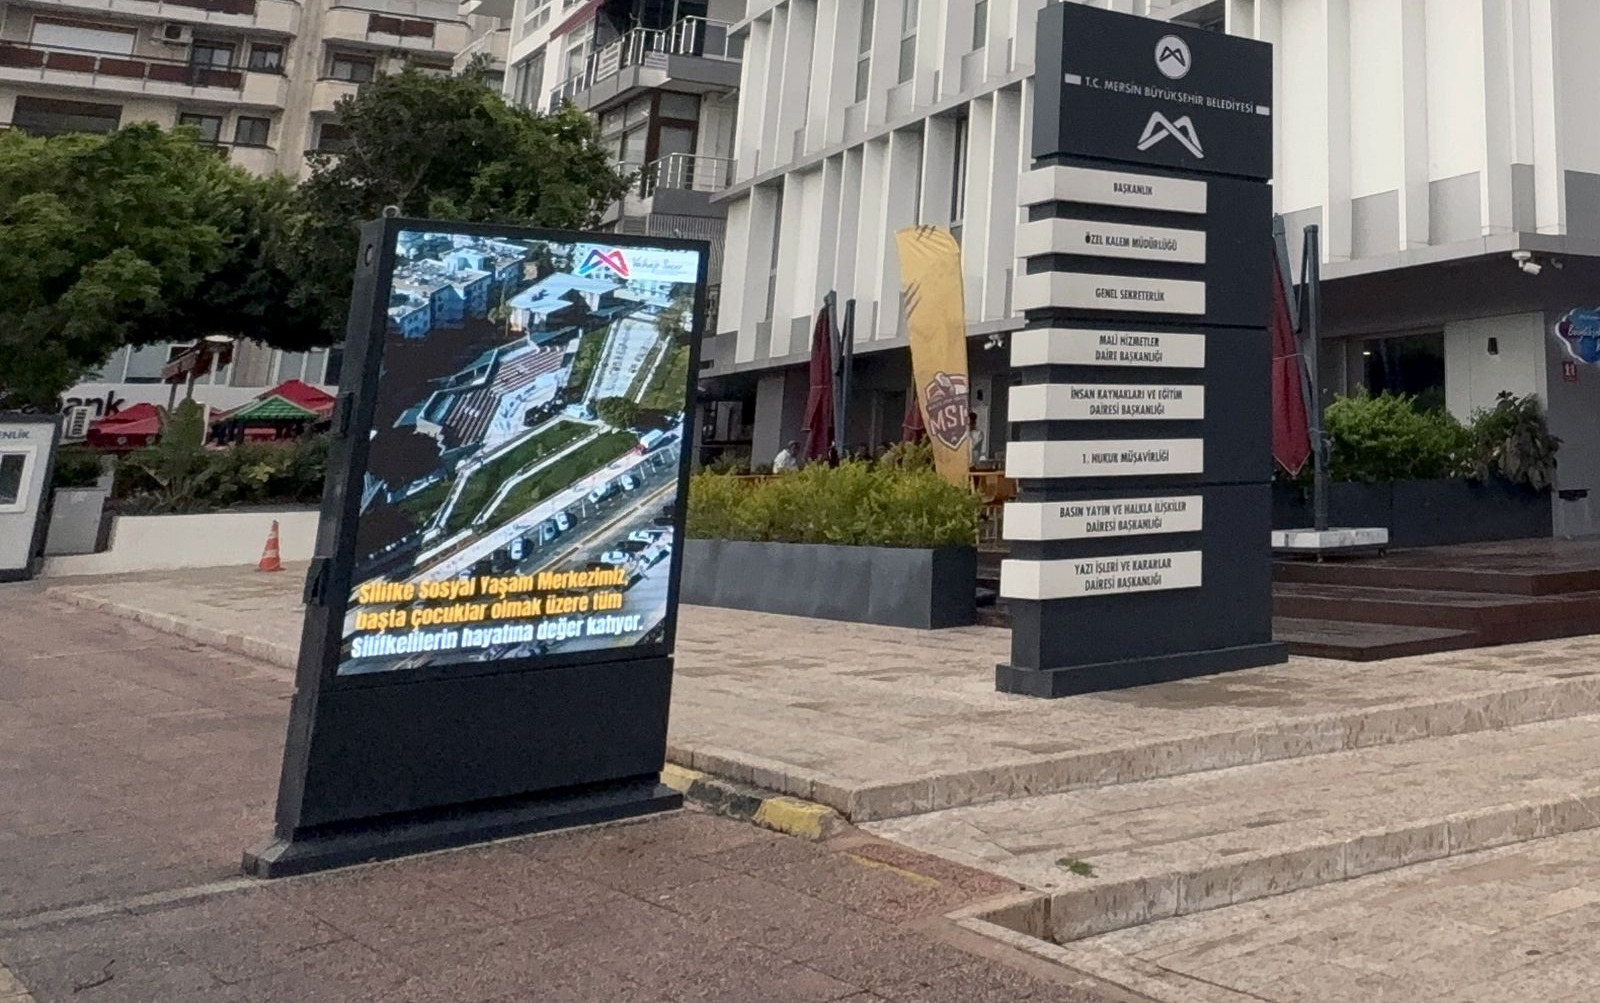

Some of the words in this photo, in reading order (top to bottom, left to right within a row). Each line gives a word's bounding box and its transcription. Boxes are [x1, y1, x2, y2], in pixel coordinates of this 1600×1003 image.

[1085, 77, 1101, 88] T.C.
[1104, 81, 1141, 95] MERSİN
[1206, 96, 1254, 113] BELEDİYESİ
[1113, 182, 1153, 195] BAŞKANLIK
[1085, 232, 1103, 245] ÖZEL
[1105, 236, 1130, 247] KALEM
[1132, 236, 1177, 251] MÜDÜRLÜĞÜ
[1095, 288, 1119, 299] GENEL
[1120, 289, 1165, 301] SEKRETERLİK
[1099, 334, 1118, 346] MALİ
[1120, 334, 1159, 347] HİZMETLER
[1095, 349, 1118, 361] DAİRE
[1120, 350, 1163, 363] BAŞKANLIĞI
[1070, 386, 1095, 399] İNSAN
[1097, 389, 1145, 399] KAYNAKLARI
[1147, 389, 1156, 399] VE
[1158, 387, 1183, 400] EĞİTİM
[1089, 402, 1119, 415] DAİRESİ
[1121, 402, 1165, 417] BAŞKANLIĞI
[1091, 452, 1118, 464] HUKUK
[1120, 449, 1169, 465] MÜŞAVİRLİĞİ
[1060, 506, 1083, 518] BASIN
[1086, 504, 1110, 516] YAYIN
[1112, 504, 1122, 515] VE
[1124, 503, 1152, 514] HALKLA
[1154, 500, 1187, 515] İLİŞKİLER
[1086, 519, 1116, 533] DAİRESİ
[1118, 516, 1162, 532] BAŞKANLIĞI
[1074, 563, 1093, 575] YAZI
[1120, 560, 1130, 571] VE
[1132, 558, 1172, 571] KARARLAR
[359, 581, 415, 604] Silifke
[418, 577, 475, 600] Sosyal
[480, 574, 533, 598] Yaşam
[538, 567, 628, 590] Merkezimiz,
[1085, 575, 1115, 591] DAİRESİ
[1117, 573, 1161, 589] BAŞKANLIĞI
[355, 609, 405, 634] başta
[411, 602, 486, 633] çocuklar
[491, 597, 541, 620] olmak
[545, 593, 590, 614] üzere
[593, 590, 622, 611] tüm
[351, 627, 458, 658] Silifkelilerin
[461, 622, 533, 648] hayatına
[536, 616, 584, 640] değer
[587, 612, 643, 635] katıyor.
